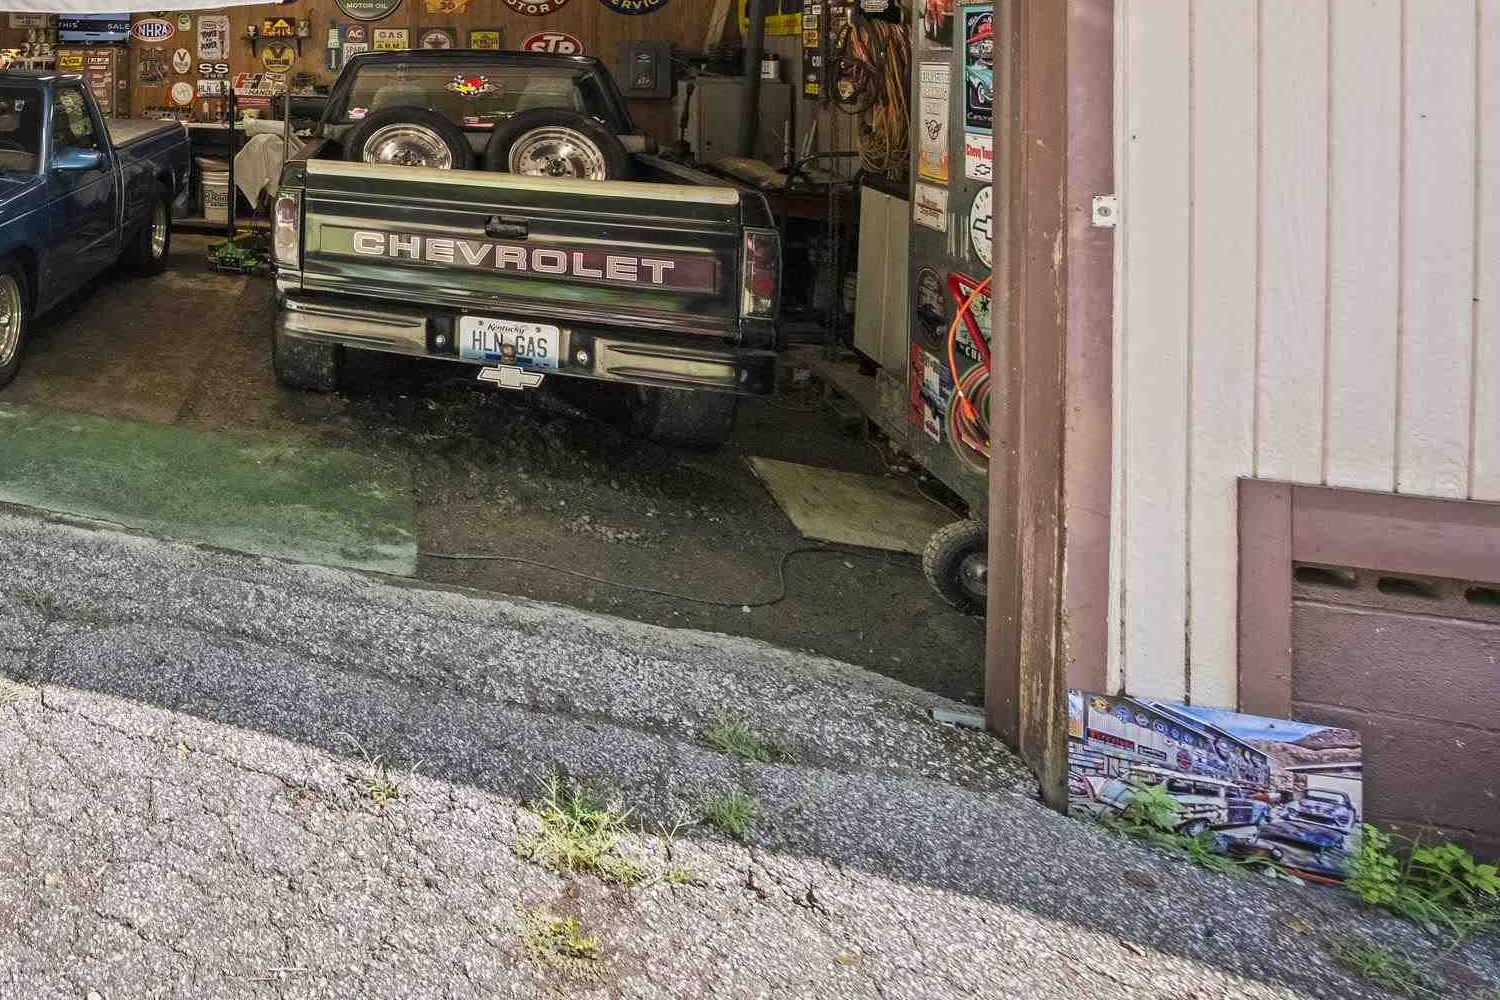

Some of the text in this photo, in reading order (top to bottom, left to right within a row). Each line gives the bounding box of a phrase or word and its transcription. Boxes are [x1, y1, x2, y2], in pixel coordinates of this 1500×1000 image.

[140, 23, 173, 38] NHRA
[348, 29, 364, 39] AC
[199, 63, 229, 74] SS
[352, 231, 676, 285] CHEVROLET
[487, 321, 525, 336] Kentucky
[471, 330, 548, 358] HLN GAS
